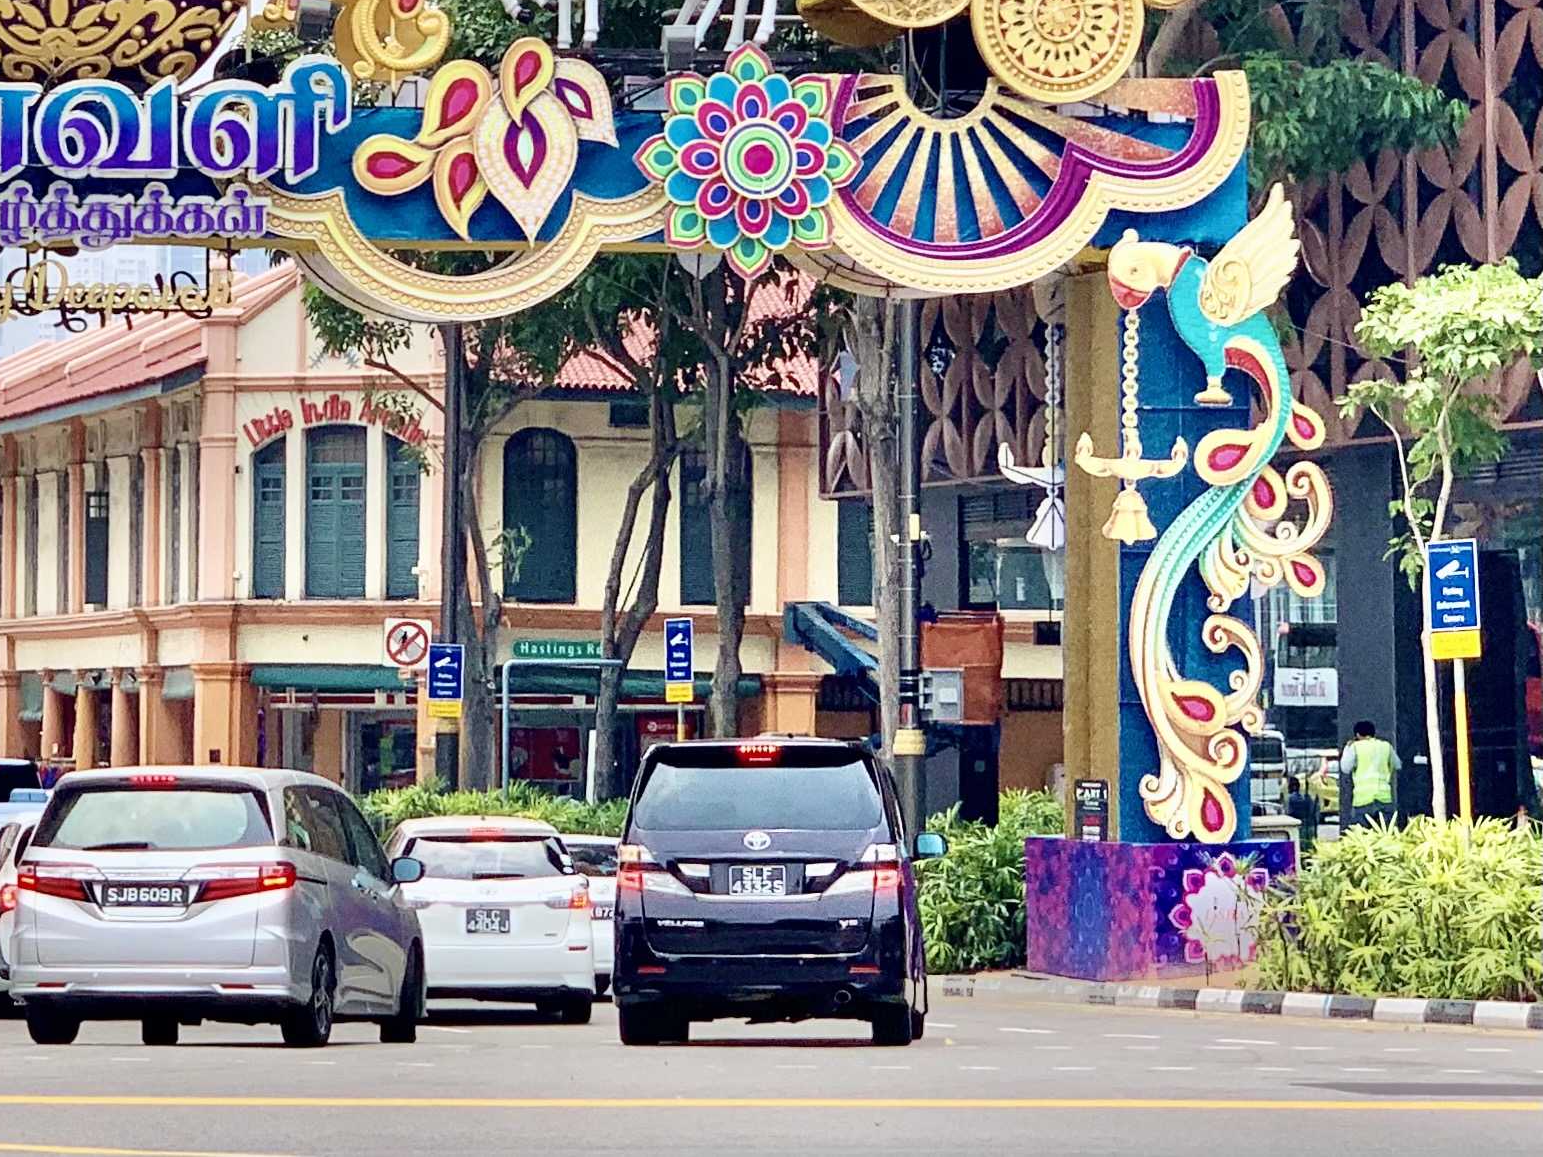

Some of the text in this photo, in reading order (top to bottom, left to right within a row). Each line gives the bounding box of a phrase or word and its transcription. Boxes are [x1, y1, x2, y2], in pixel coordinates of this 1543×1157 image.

[22, 259, 237, 319] Deepavali
[300, 394, 351, 424] India
[359, 398, 429, 446] Arcde
[520, 642, 582, 658] Hastings
[742, 867, 773, 880] SLF
[731, 879, 784, 894] 4332S
[107, 887, 183, 902] SJB609R
[475, 910, 501, 921] SLC
[467, 920, 509, 932] 4404J
